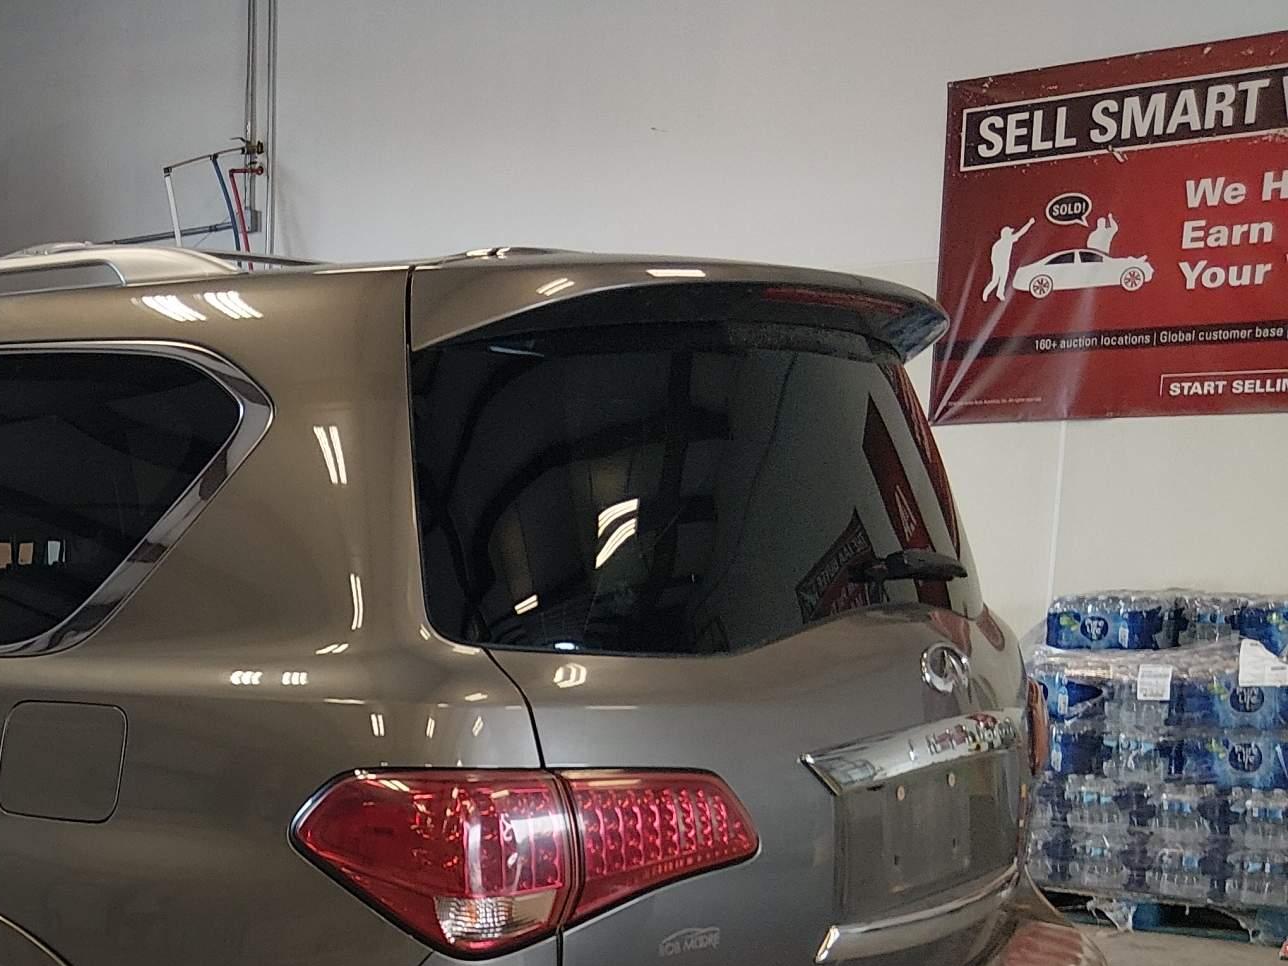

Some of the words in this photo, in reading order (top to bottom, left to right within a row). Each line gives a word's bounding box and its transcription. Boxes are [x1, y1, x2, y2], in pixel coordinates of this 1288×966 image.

[977, 106, 1077, 159] SELL
[1089, 79, 1271, 145] SMART
[1185, 176, 1246, 209] We
[1052, 202, 1086, 217] SOLD!
[1181, 220, 1274, 249] Earn
[1178, 259, 1272, 290] Your
[1034, 339, 1057, 351] 160+
[1059, 336, 1098, 349] auction
[1100, 334, 1150, 347] locations
[1159, 329, 1195, 343] Global
[1198, 326, 1252, 341] customer
[1255, 326, 1283, 338] base
[1169, 381, 1227, 396] START
